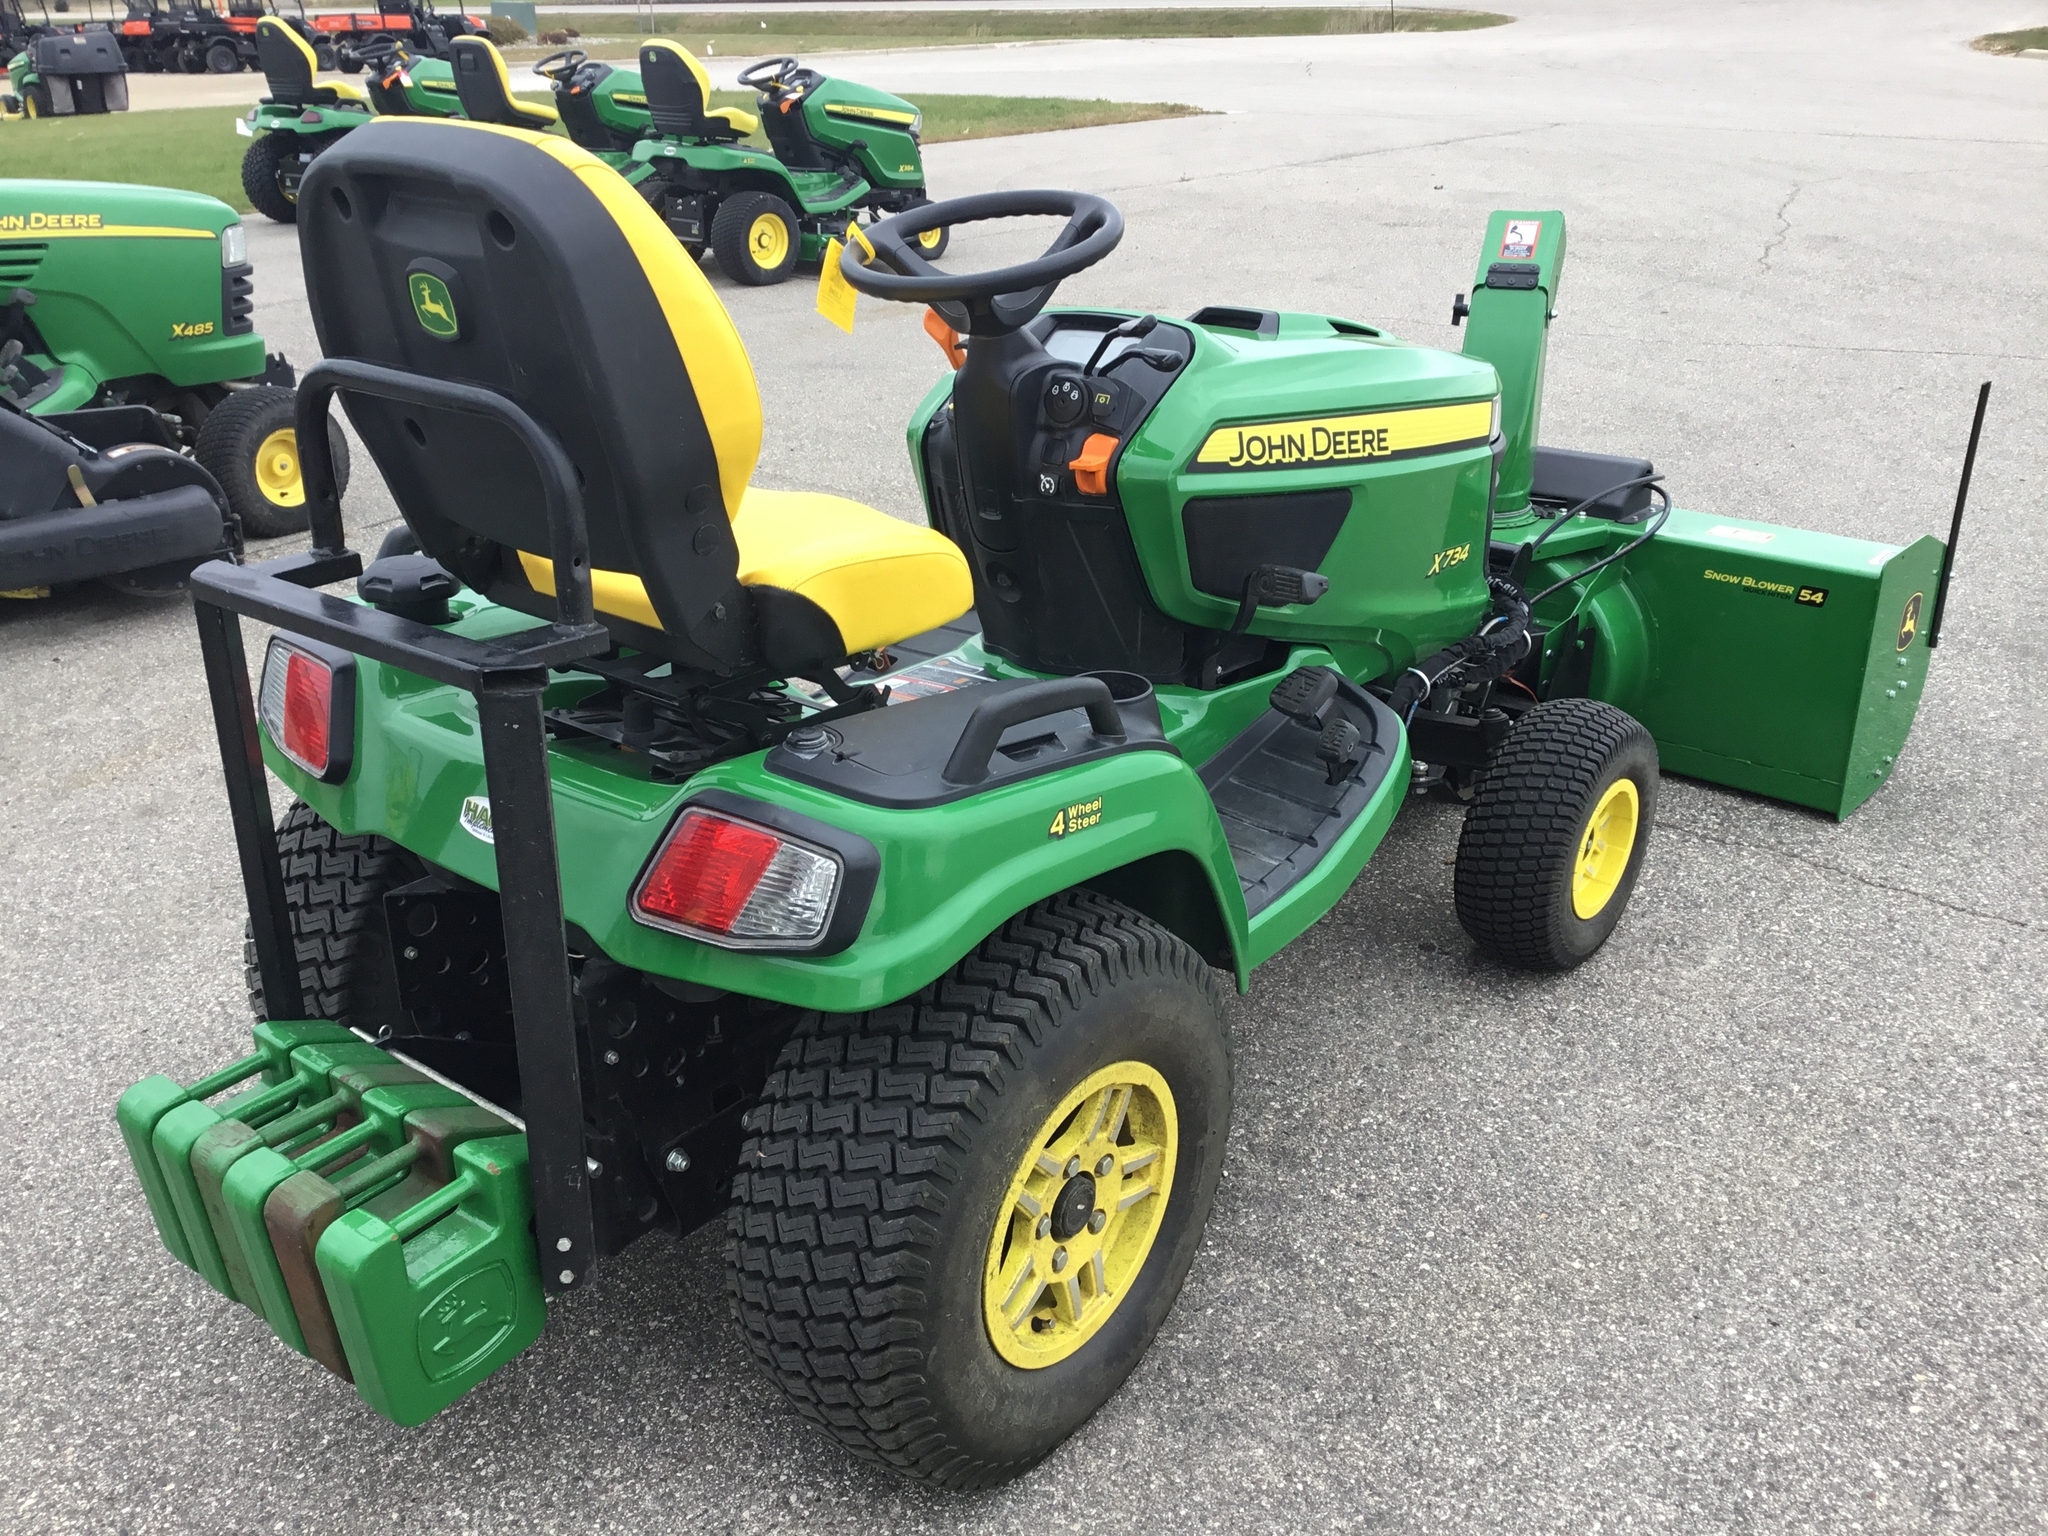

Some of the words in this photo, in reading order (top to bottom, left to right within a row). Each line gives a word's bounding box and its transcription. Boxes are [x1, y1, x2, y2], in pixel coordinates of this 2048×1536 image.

[841, 105, 856, 114] JOHN
[30, 212, 102, 229] DEERE
[171, 321, 214, 339] X485
[1229, 430, 1306, 464] JOHN
[1311, 426, 1390, 458] DEERE
[1426, 543, 1471, 577] X734
[1703, 569, 1741, 585] SNOW
[1741, 576, 1795, 595] BLOWER
[1797, 588, 1825, 605] 54
[1742, 586, 1767, 597] QUICK
[1767, 590, 1792, 601] HITCH
[463, 798, 492, 827] HA
[1049, 809, 1066, 838] 4
[1067, 795, 1103, 820] Wheel
[1067, 812, 1102, 833] Steer
